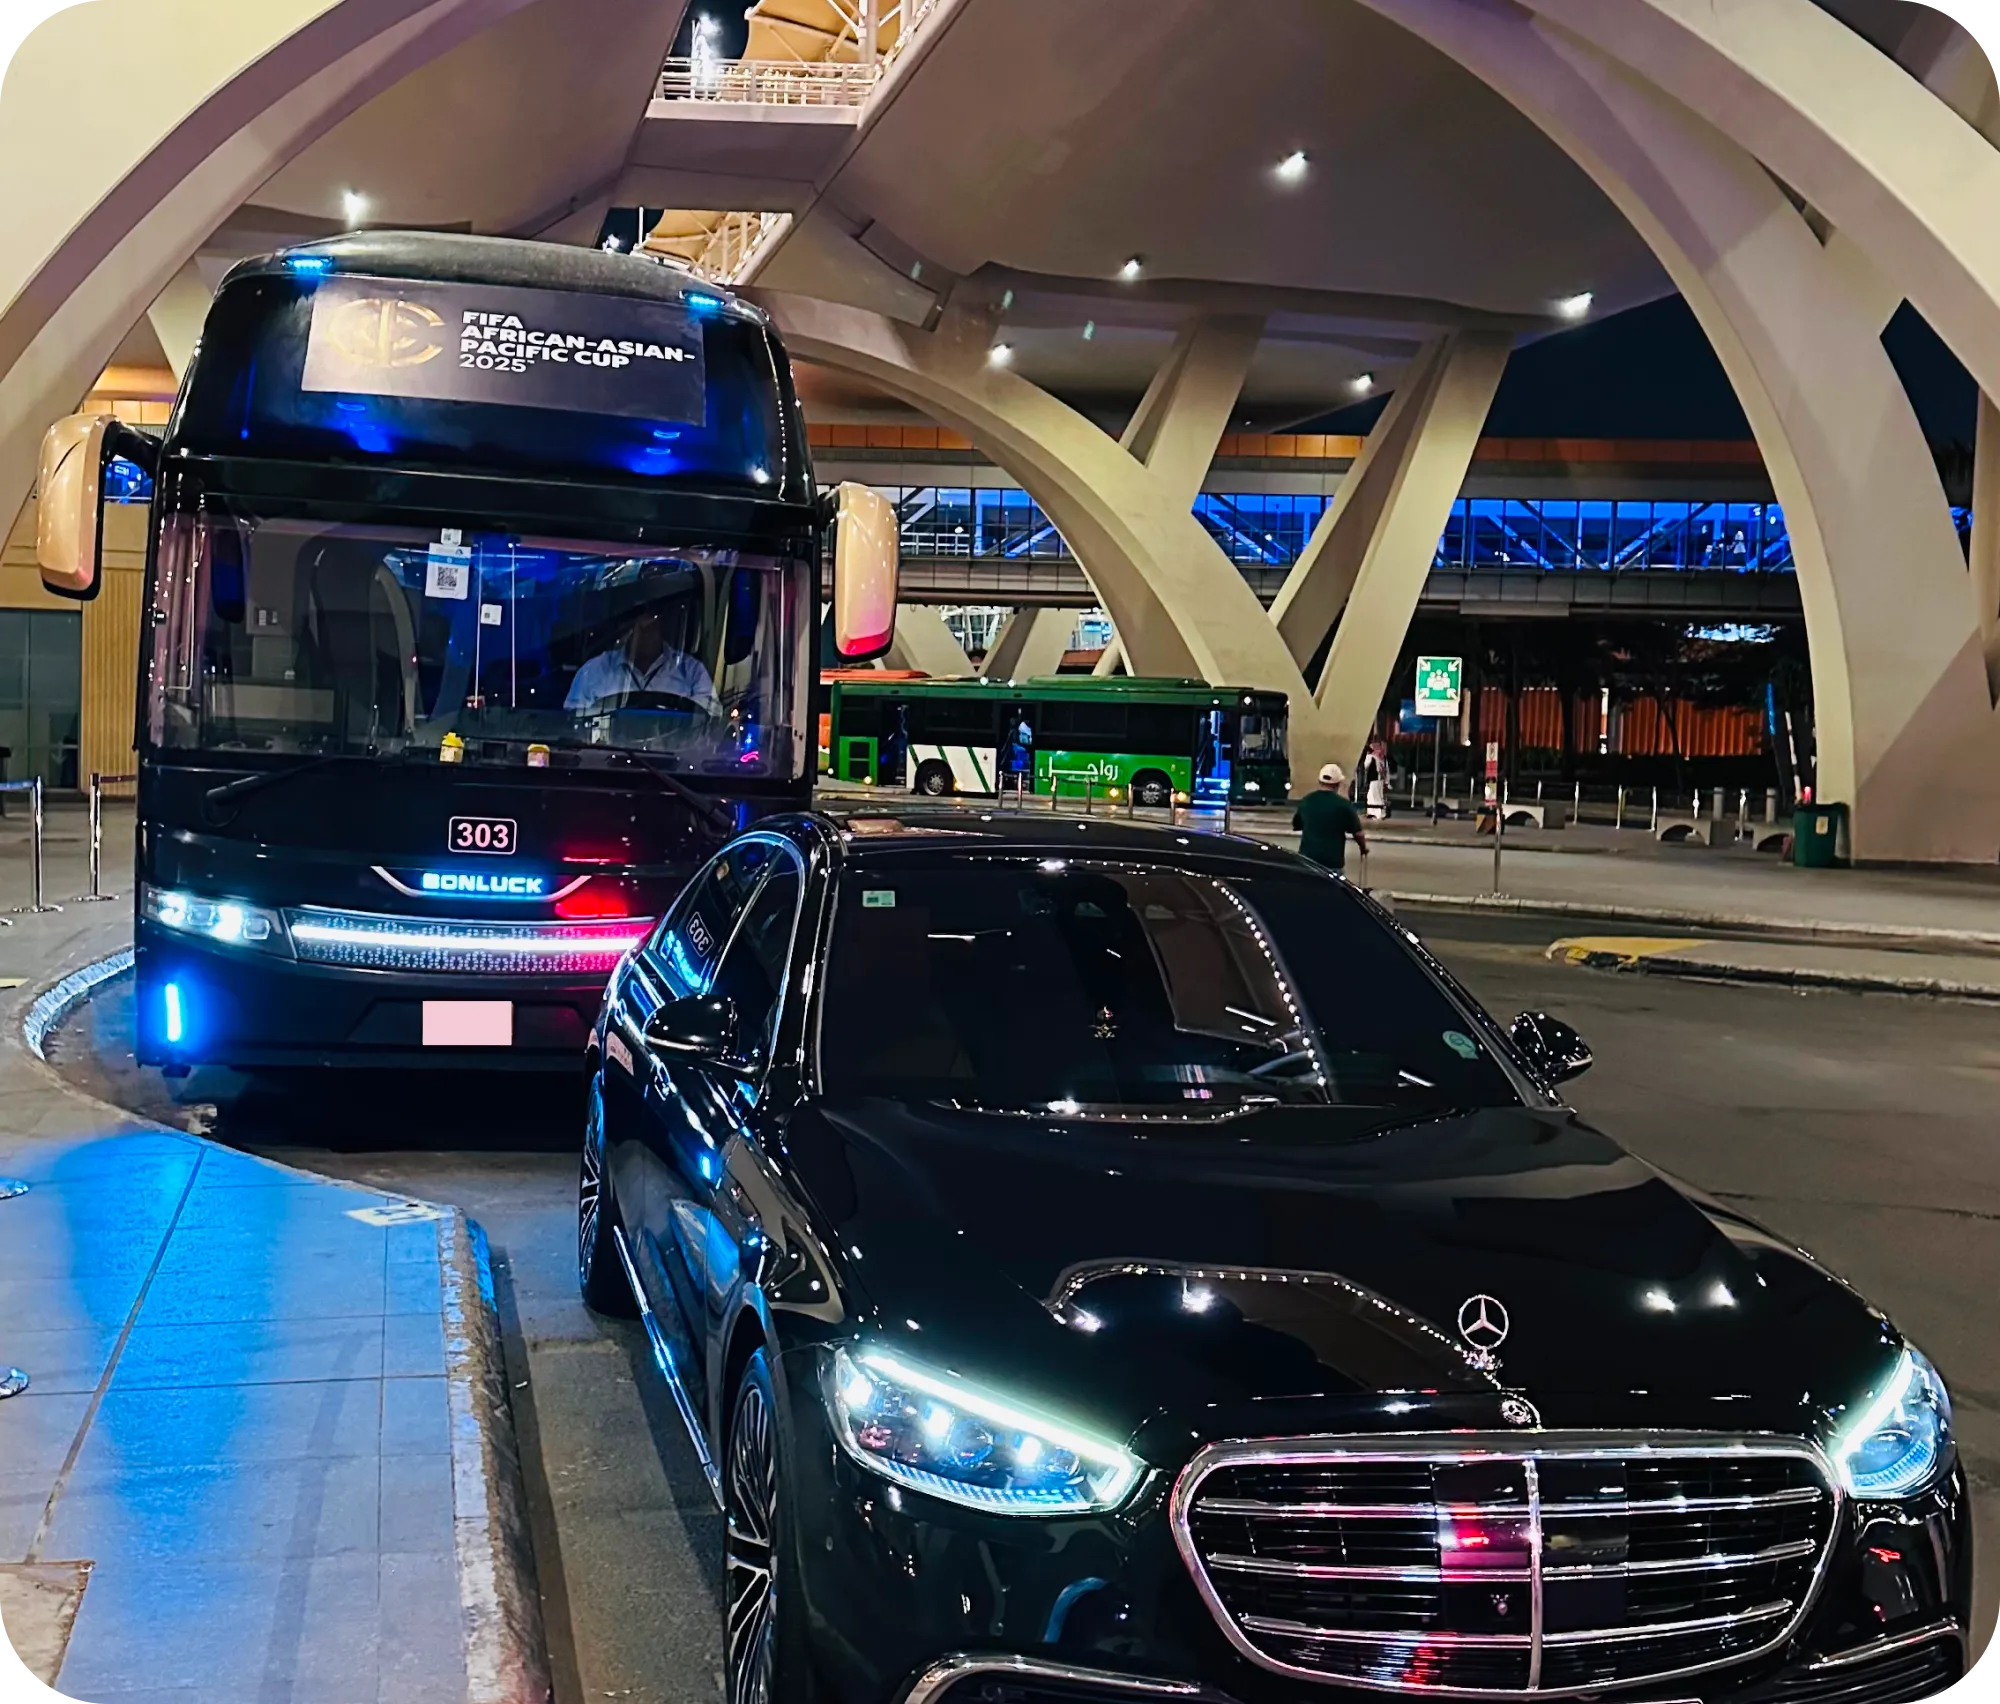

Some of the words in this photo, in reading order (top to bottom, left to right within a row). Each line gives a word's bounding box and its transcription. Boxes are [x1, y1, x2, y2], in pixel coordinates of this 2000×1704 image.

[463, 311, 524, 329] FIFA
[460, 338, 569, 363] PACIFIC
[573, 351, 630, 368] CUP
[456, 823, 509, 848] 303
